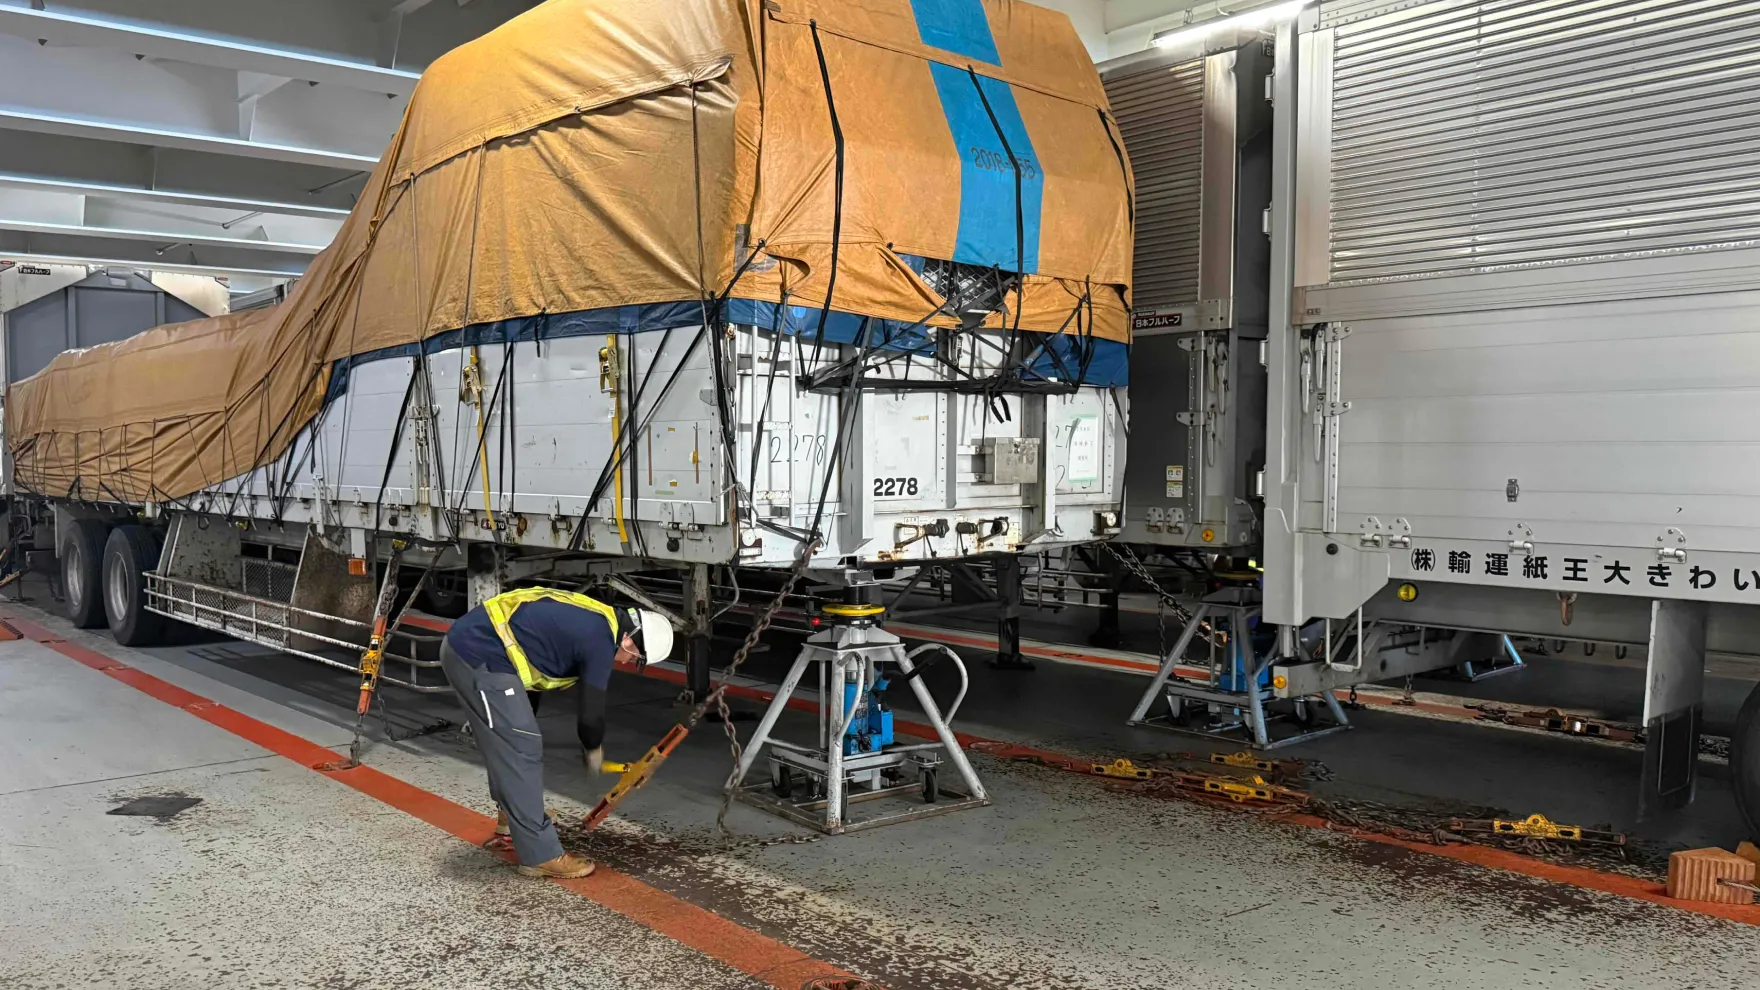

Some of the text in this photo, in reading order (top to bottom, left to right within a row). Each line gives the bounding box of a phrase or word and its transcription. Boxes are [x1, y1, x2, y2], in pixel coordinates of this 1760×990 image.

[970, 147, 1036, 179] 2018-55
[1135, 315, 1180, 328] 日本フルハーフ
[873, 477, 918, 497] 2278
